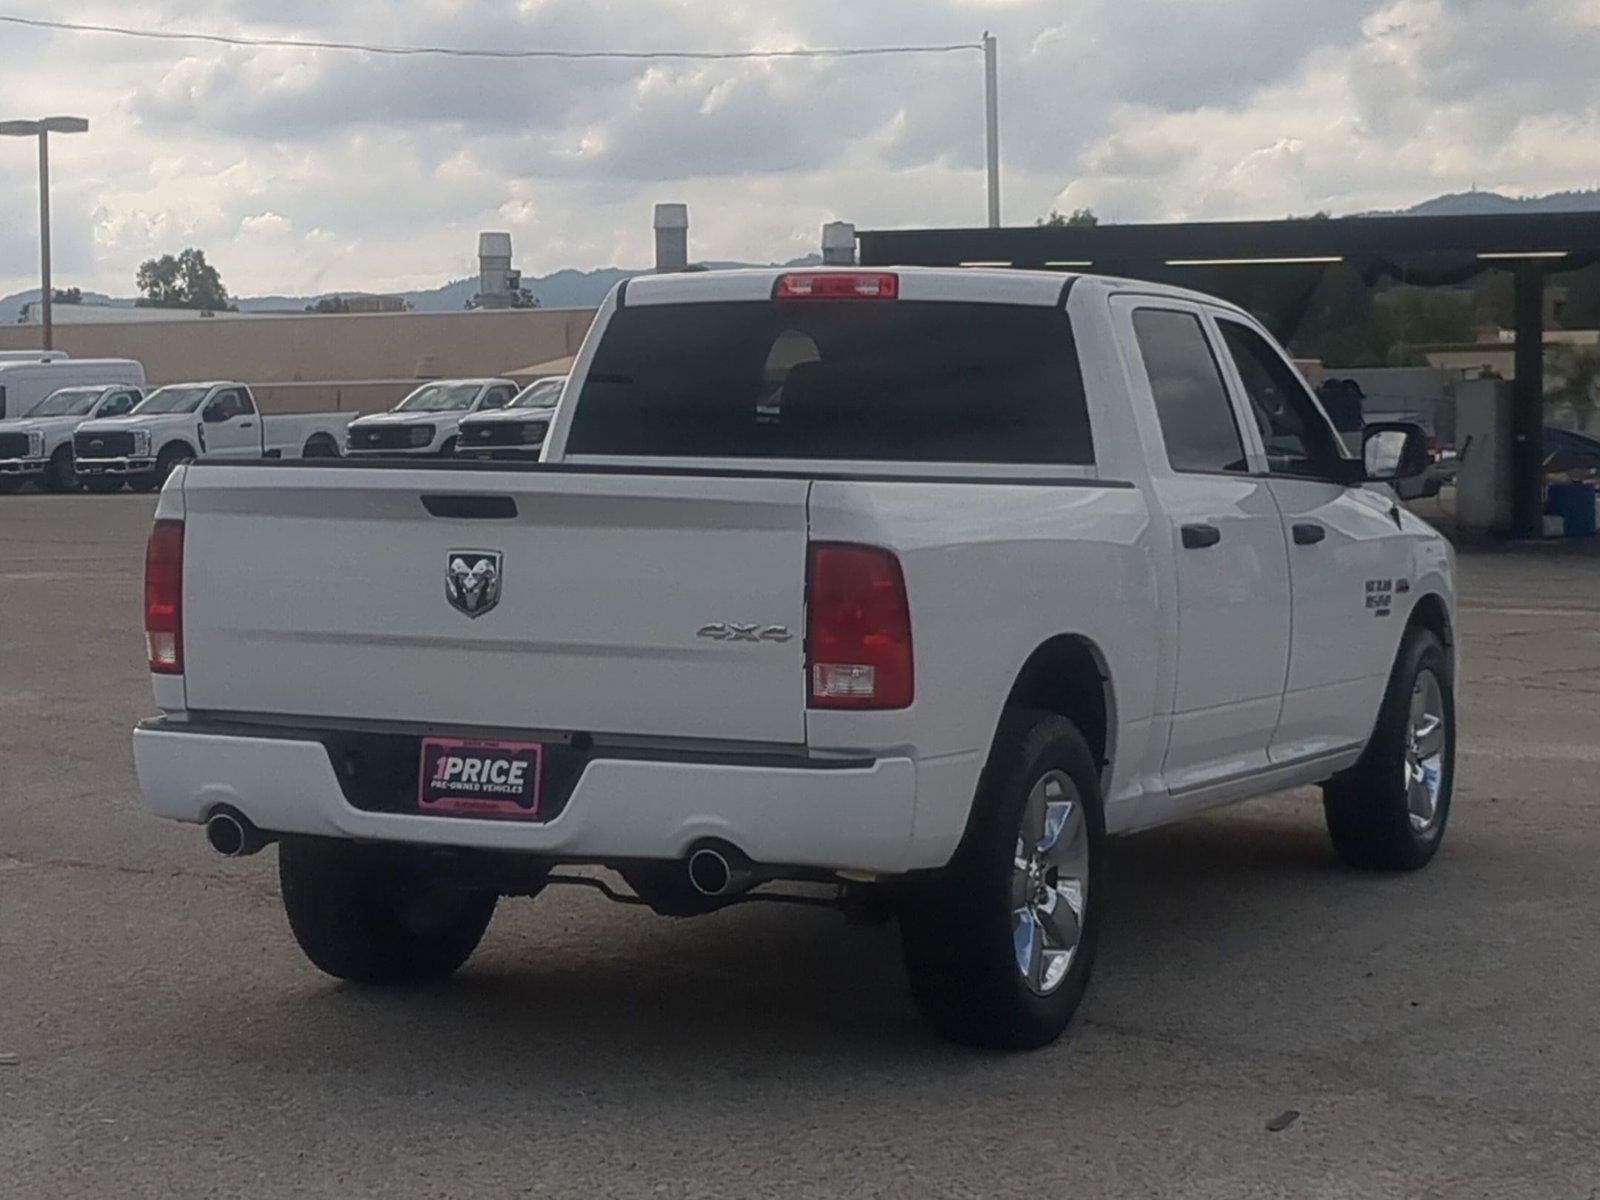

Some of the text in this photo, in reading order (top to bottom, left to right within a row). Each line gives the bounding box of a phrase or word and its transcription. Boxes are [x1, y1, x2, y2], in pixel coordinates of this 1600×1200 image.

[433, 756, 528, 785] 1PRICE
[430, 780, 523, 794] PRE-OWNED VEHICLES
